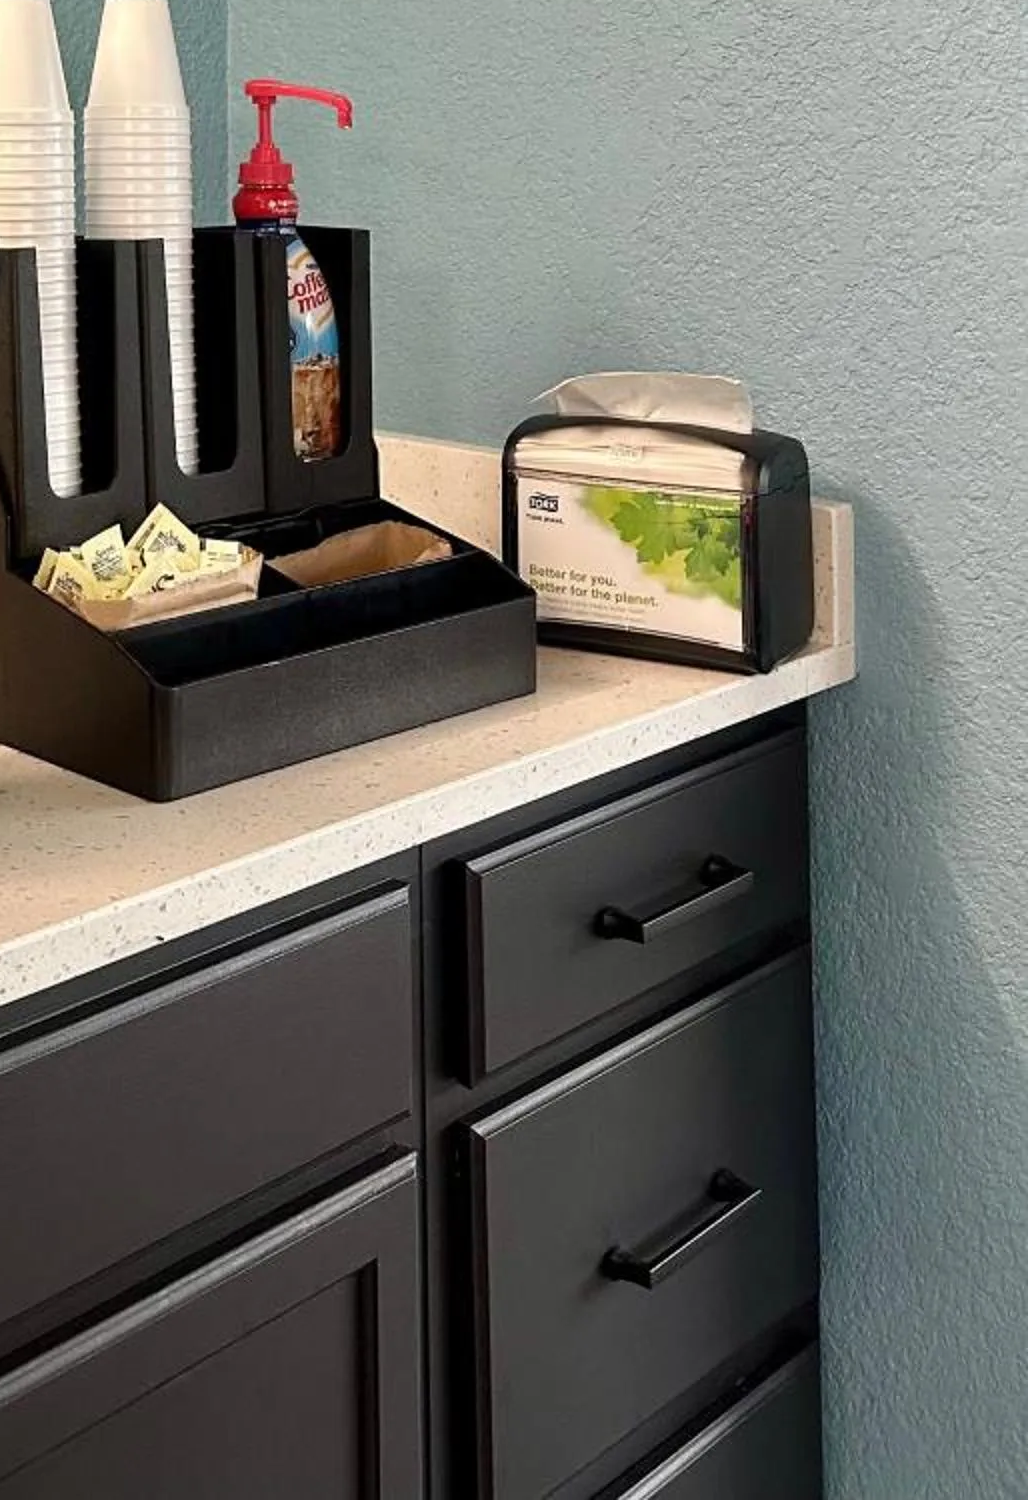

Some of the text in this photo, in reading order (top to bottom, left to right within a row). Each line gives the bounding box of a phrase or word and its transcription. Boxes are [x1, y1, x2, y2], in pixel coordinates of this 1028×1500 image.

[529, 563, 566, 580] Better
[569, 569, 587, 582] for
[569, 585, 588, 597] for
[591, 588, 611, 601] the
